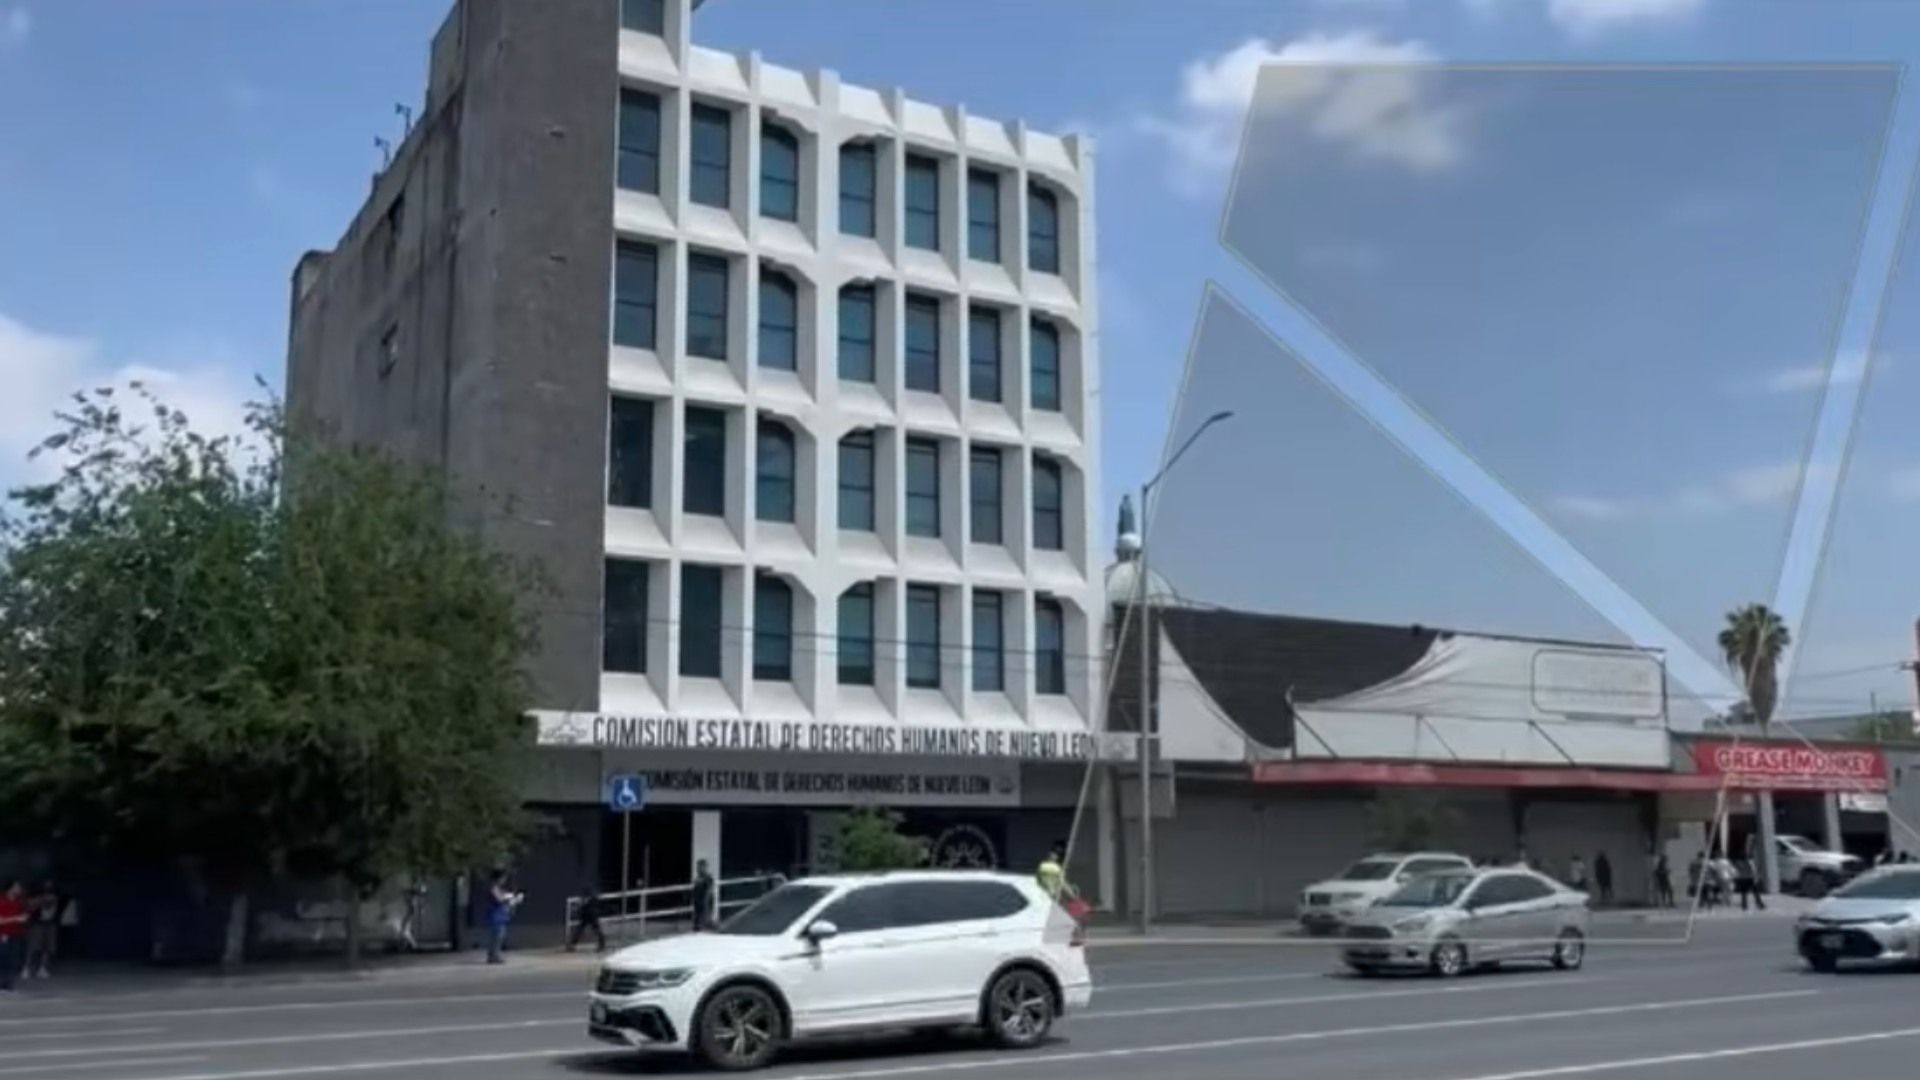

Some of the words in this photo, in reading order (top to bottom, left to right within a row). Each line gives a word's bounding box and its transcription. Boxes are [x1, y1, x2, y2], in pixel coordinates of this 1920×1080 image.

[593, 717, 688, 747] COMISION
[696, 718, 771, 748] ESTATAL
[781, 722, 802, 750] DE
[809, 723, 896, 753] DERECHOS
[902, 727, 980, 755] HUMANOS
[986, 730, 1004, 756] DE
[1010, 731, 1056, 758] NUEVO
[1716, 748, 1791, 773] GREASE
[1795, 751, 1874, 775] MONKEY
[707, 770, 761, 790] ESTATAL
